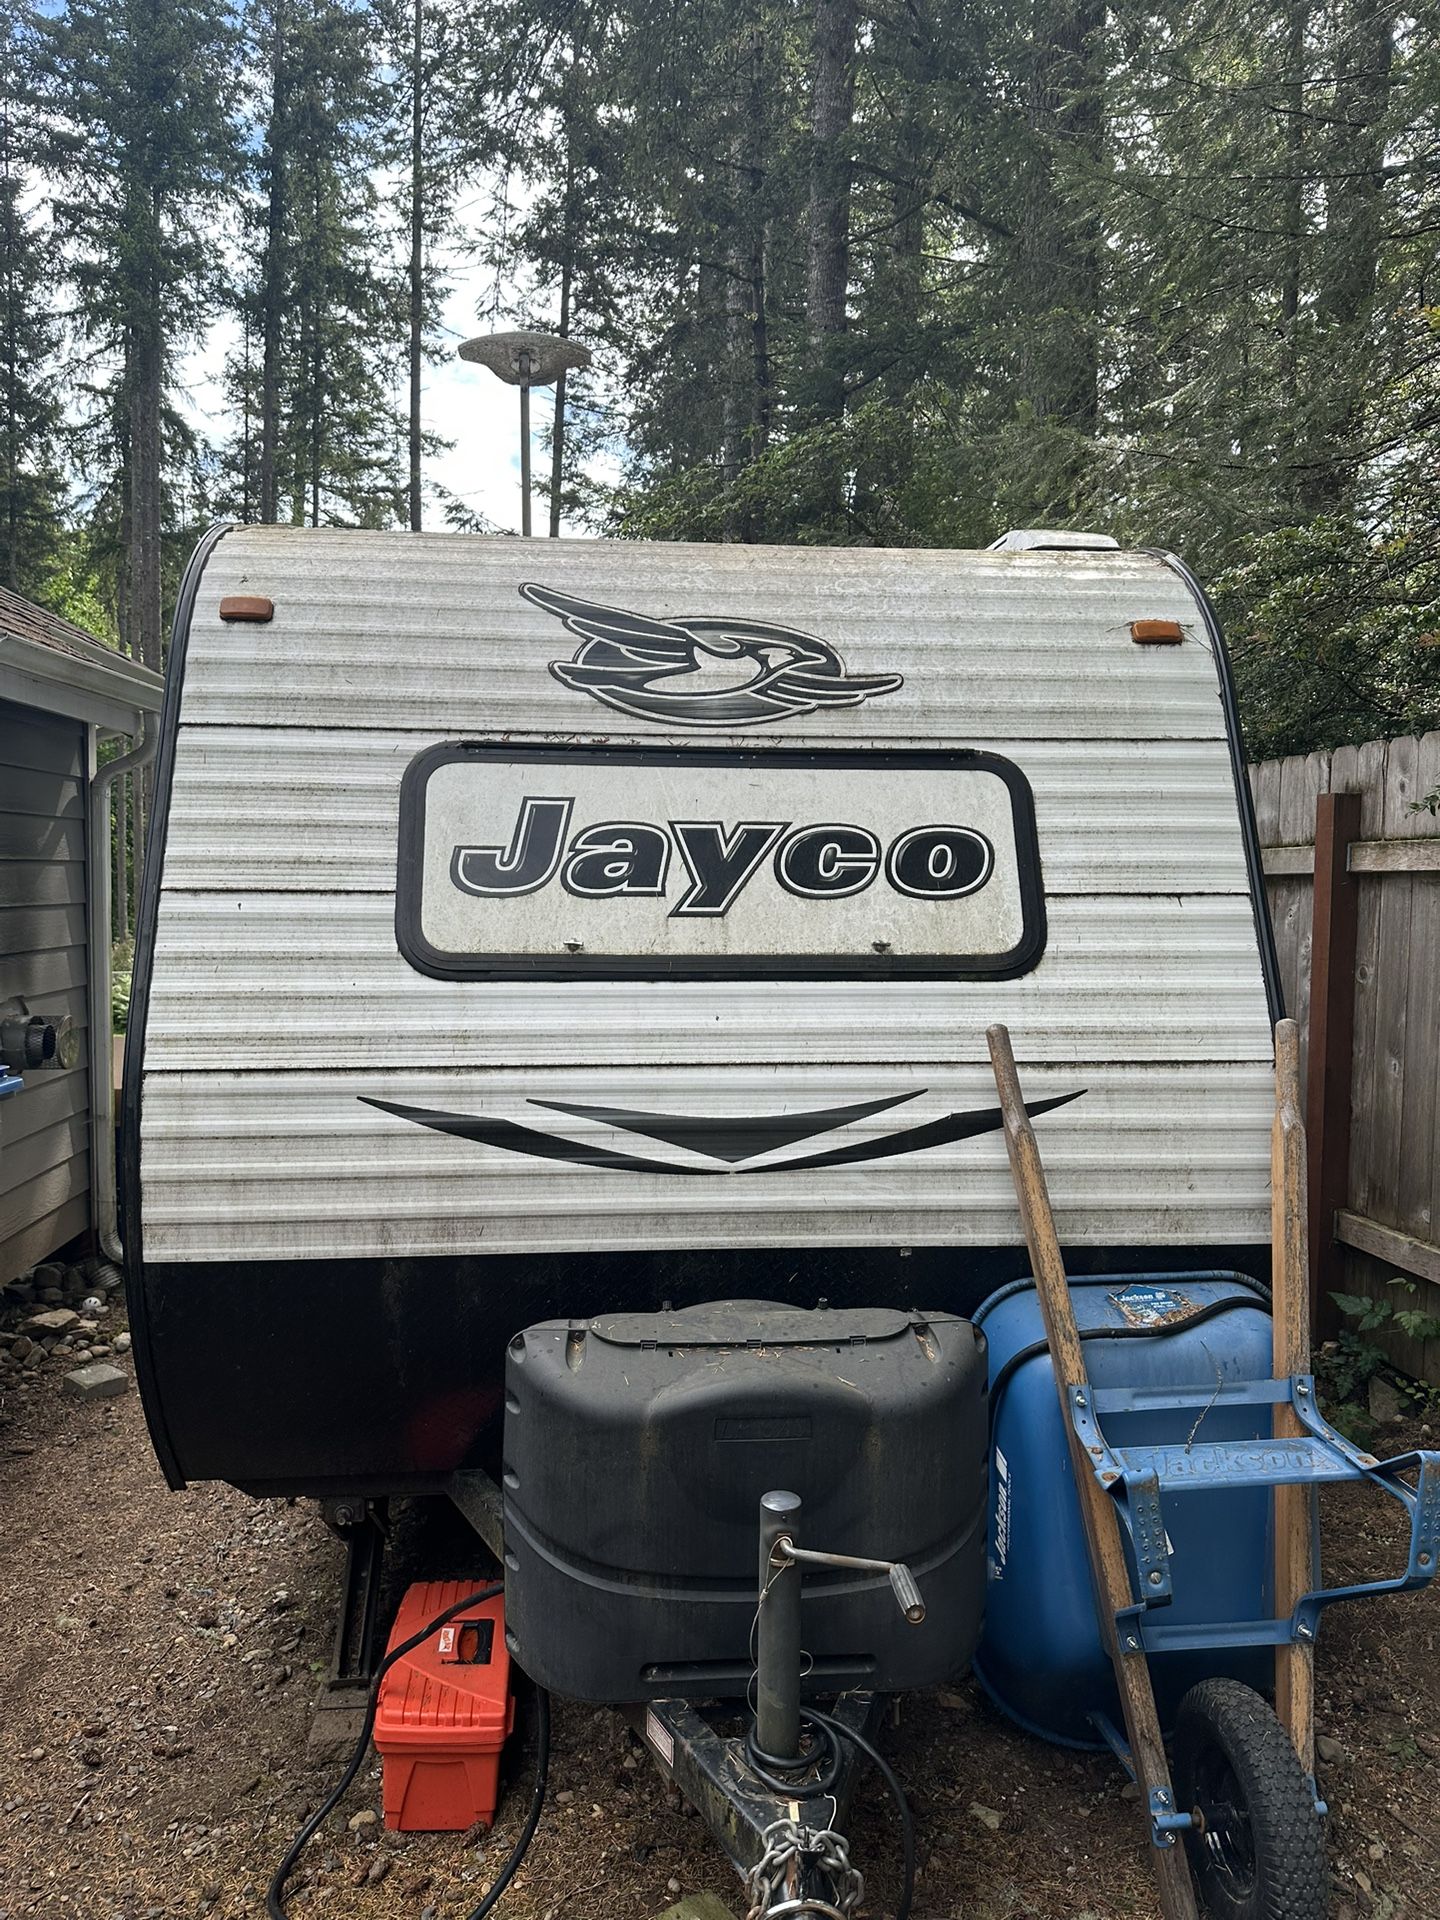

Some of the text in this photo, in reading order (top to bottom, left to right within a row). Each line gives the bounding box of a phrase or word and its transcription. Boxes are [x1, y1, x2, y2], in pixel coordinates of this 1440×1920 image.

[450, 796, 995, 918] Jayco
[1120, 1294, 1154, 1302] Jackson
[1153, 1449, 1314, 1478] Jackson
